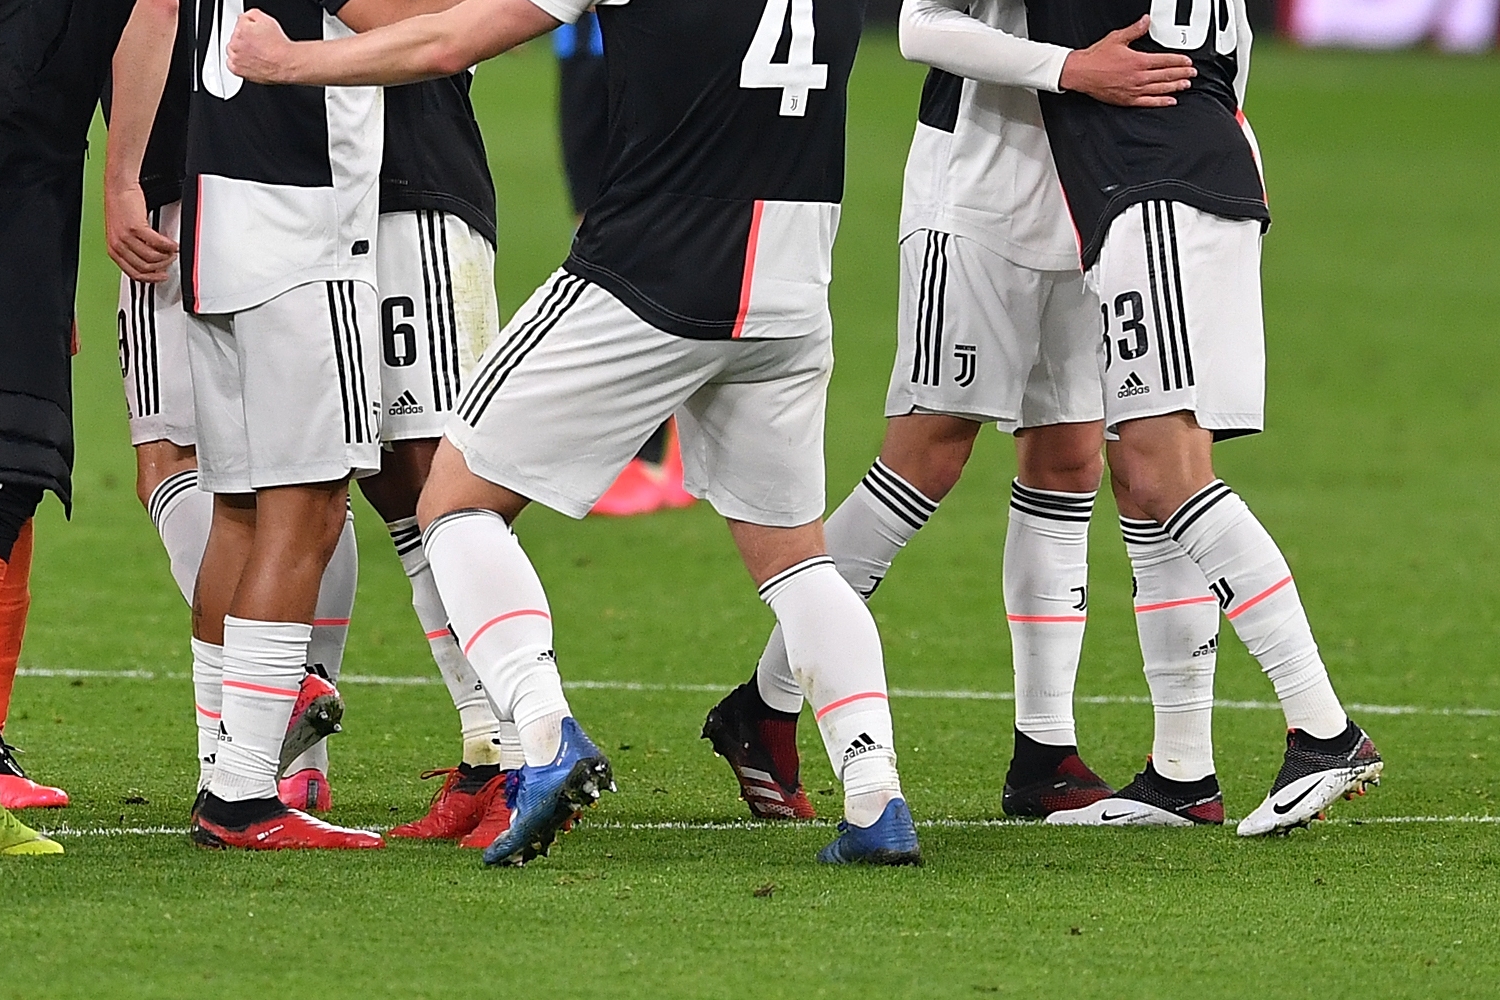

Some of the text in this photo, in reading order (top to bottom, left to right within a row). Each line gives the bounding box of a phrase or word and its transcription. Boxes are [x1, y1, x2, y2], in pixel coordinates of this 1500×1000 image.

[381, 296, 417, 367] 6
[1117, 384, 1150, 399] adidas
[388, 403, 424, 416] adidas
[843, 744, 883, 762] adidas
